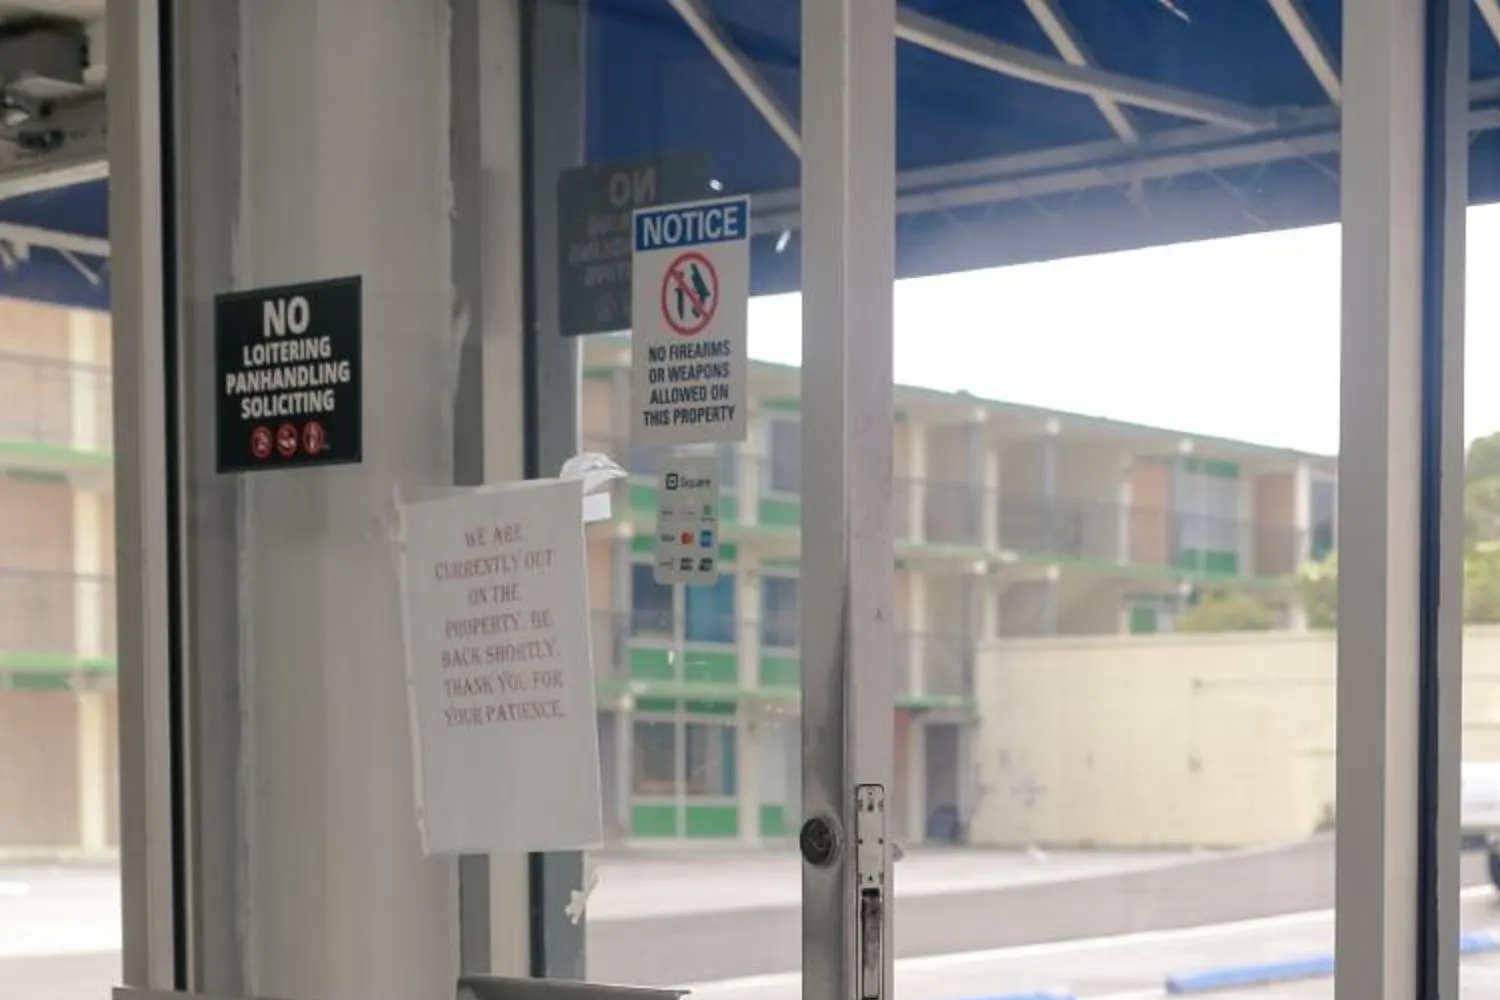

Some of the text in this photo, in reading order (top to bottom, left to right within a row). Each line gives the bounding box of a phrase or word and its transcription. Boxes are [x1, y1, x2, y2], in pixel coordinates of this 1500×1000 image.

[643, 205, 738, 247] NOTICE
[262, 295, 310, 338] NO
[242, 335, 332, 367] LOITERING
[648, 339, 731, 363] NO FIREARMS
[225, 360, 351, 396] PANHANDLING
[649, 362, 730, 383] OR WEAPONS
[240, 389, 335, 420] SOLICITING
[649, 383, 729, 405] ALLOWED ON
[643, 405, 736, 427] THIS PROPERTY
[464, 523, 523, 548] WE ARE
[434, 547, 557, 580] CURRENTLY OUT
[468, 583, 522, 606] ON THE
[441, 646, 481, 668] BACK
[444, 669, 565, 697] THANK YOU FOR
[444, 707, 482, 727] YOUR
